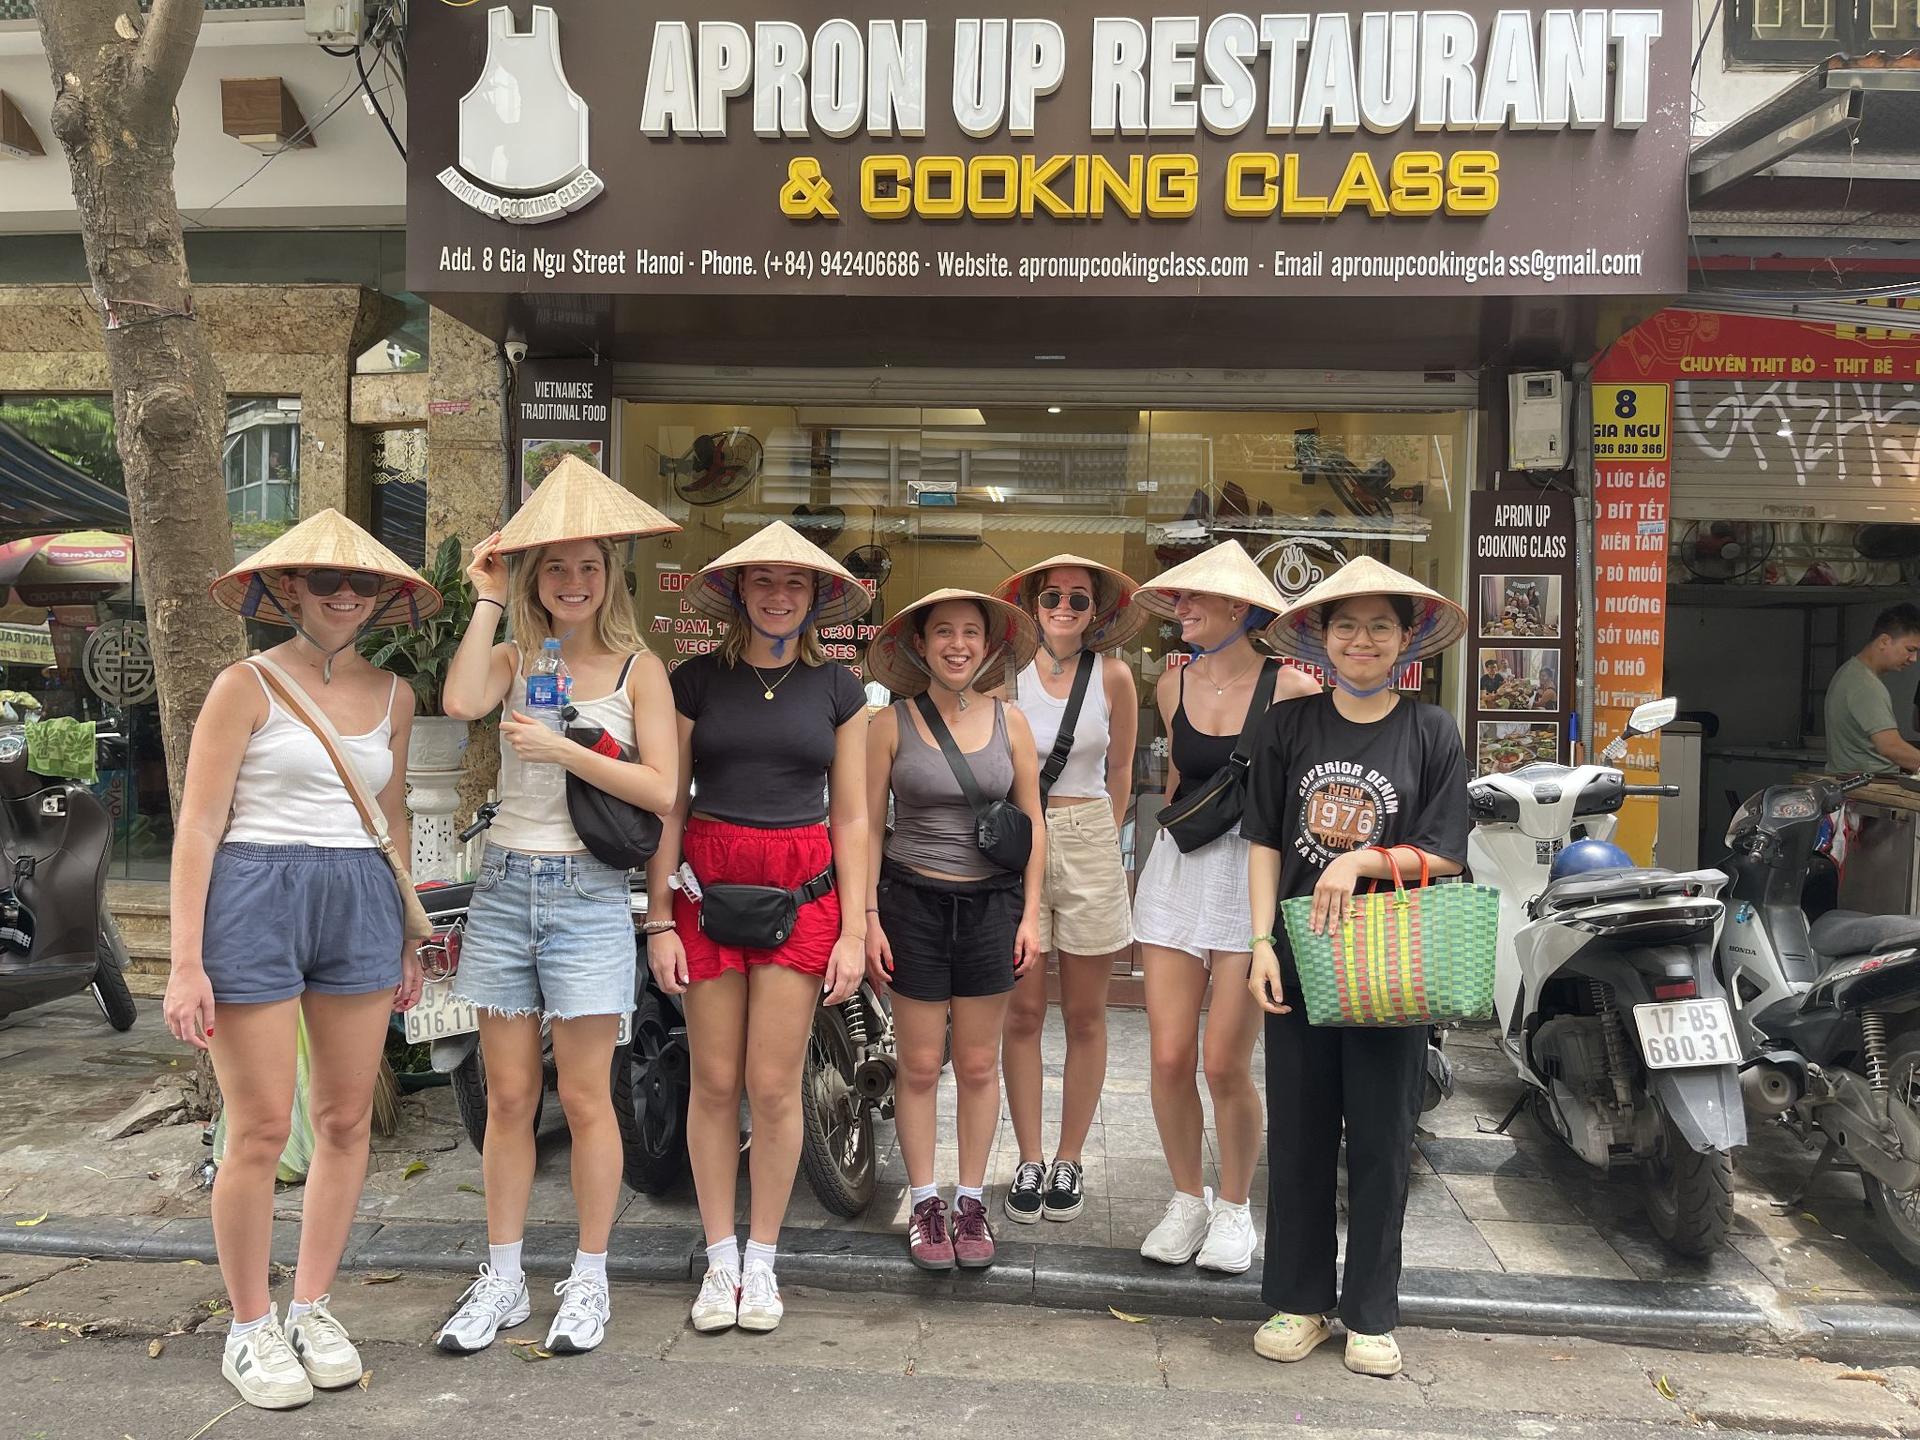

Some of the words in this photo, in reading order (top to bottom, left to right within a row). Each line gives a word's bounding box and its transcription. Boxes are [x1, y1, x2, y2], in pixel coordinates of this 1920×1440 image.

[640, 19, 927, 137] APRON
[952, 18, 1066, 137] UP
[1091, 9, 1662, 136] RESTAURANT
[440, 169, 478, 204] APRON
[480, 193, 499, 213] UP
[501, 195, 558, 218] COOKING
[557, 171, 596, 204] CLASS
[780, 157, 840, 219] &
[860, 154, 1198, 219] COOKING
[1225, 150, 1500, 218] CLASS
[439, 246, 475, 271] Add.
[482, 247, 493, 271] 8
[499, 248, 526, 273] Gia
[533, 248, 565, 278] Ngu
[572, 248, 626, 274] Street
[636, 249, 684, 275] Hanoi
[701, 250, 756, 275] Phone.
[763, 249, 814, 279] (+84)
[820, 250, 920, 276] 942406686
[937, 251, 1012, 277] Website.
[1019, 251, 1249, 282] apronupcookingclass.com
[1274, 251, 1323, 277] Email
[1680, 353, 1747, 373] CHUYÊN
[1791, 354, 1816, 372] BÒ
[534, 381, 594, 399] VIETNAMESE
[520, 403, 580, 421] TRADITIONAL
[582, 405, 607, 422] FOOD
[1614, 389, 1637, 419] 8
[1617, 443, 1638, 454] 830
[1642, 443, 1662, 454] 366
[1606, 468, 1634, 488] LÚC
[1495, 505, 1533, 528] APRON
[1536, 505, 1551, 528] UP
[1607, 500, 1633, 519] BÍT
[1478, 535, 1527, 558] COOKING
[1530, 535, 1567, 558] CLASS
[1607, 563, 1624, 582] BÒ
[650, 619, 672, 633] AT
[1614, 657, 1646, 676] KHÔ
[1328, 782, 1365, 800] NEW
[1364, 769, 1399, 815] DENIM
[1309, 799, 1374, 835] 1976
[1294, 836, 1327, 869] EAST
[1319, 832, 1357, 851] YORK
[410, 1004, 474, 1038] 916.11
[1647, 1032, 1735, 1064] 680.31
